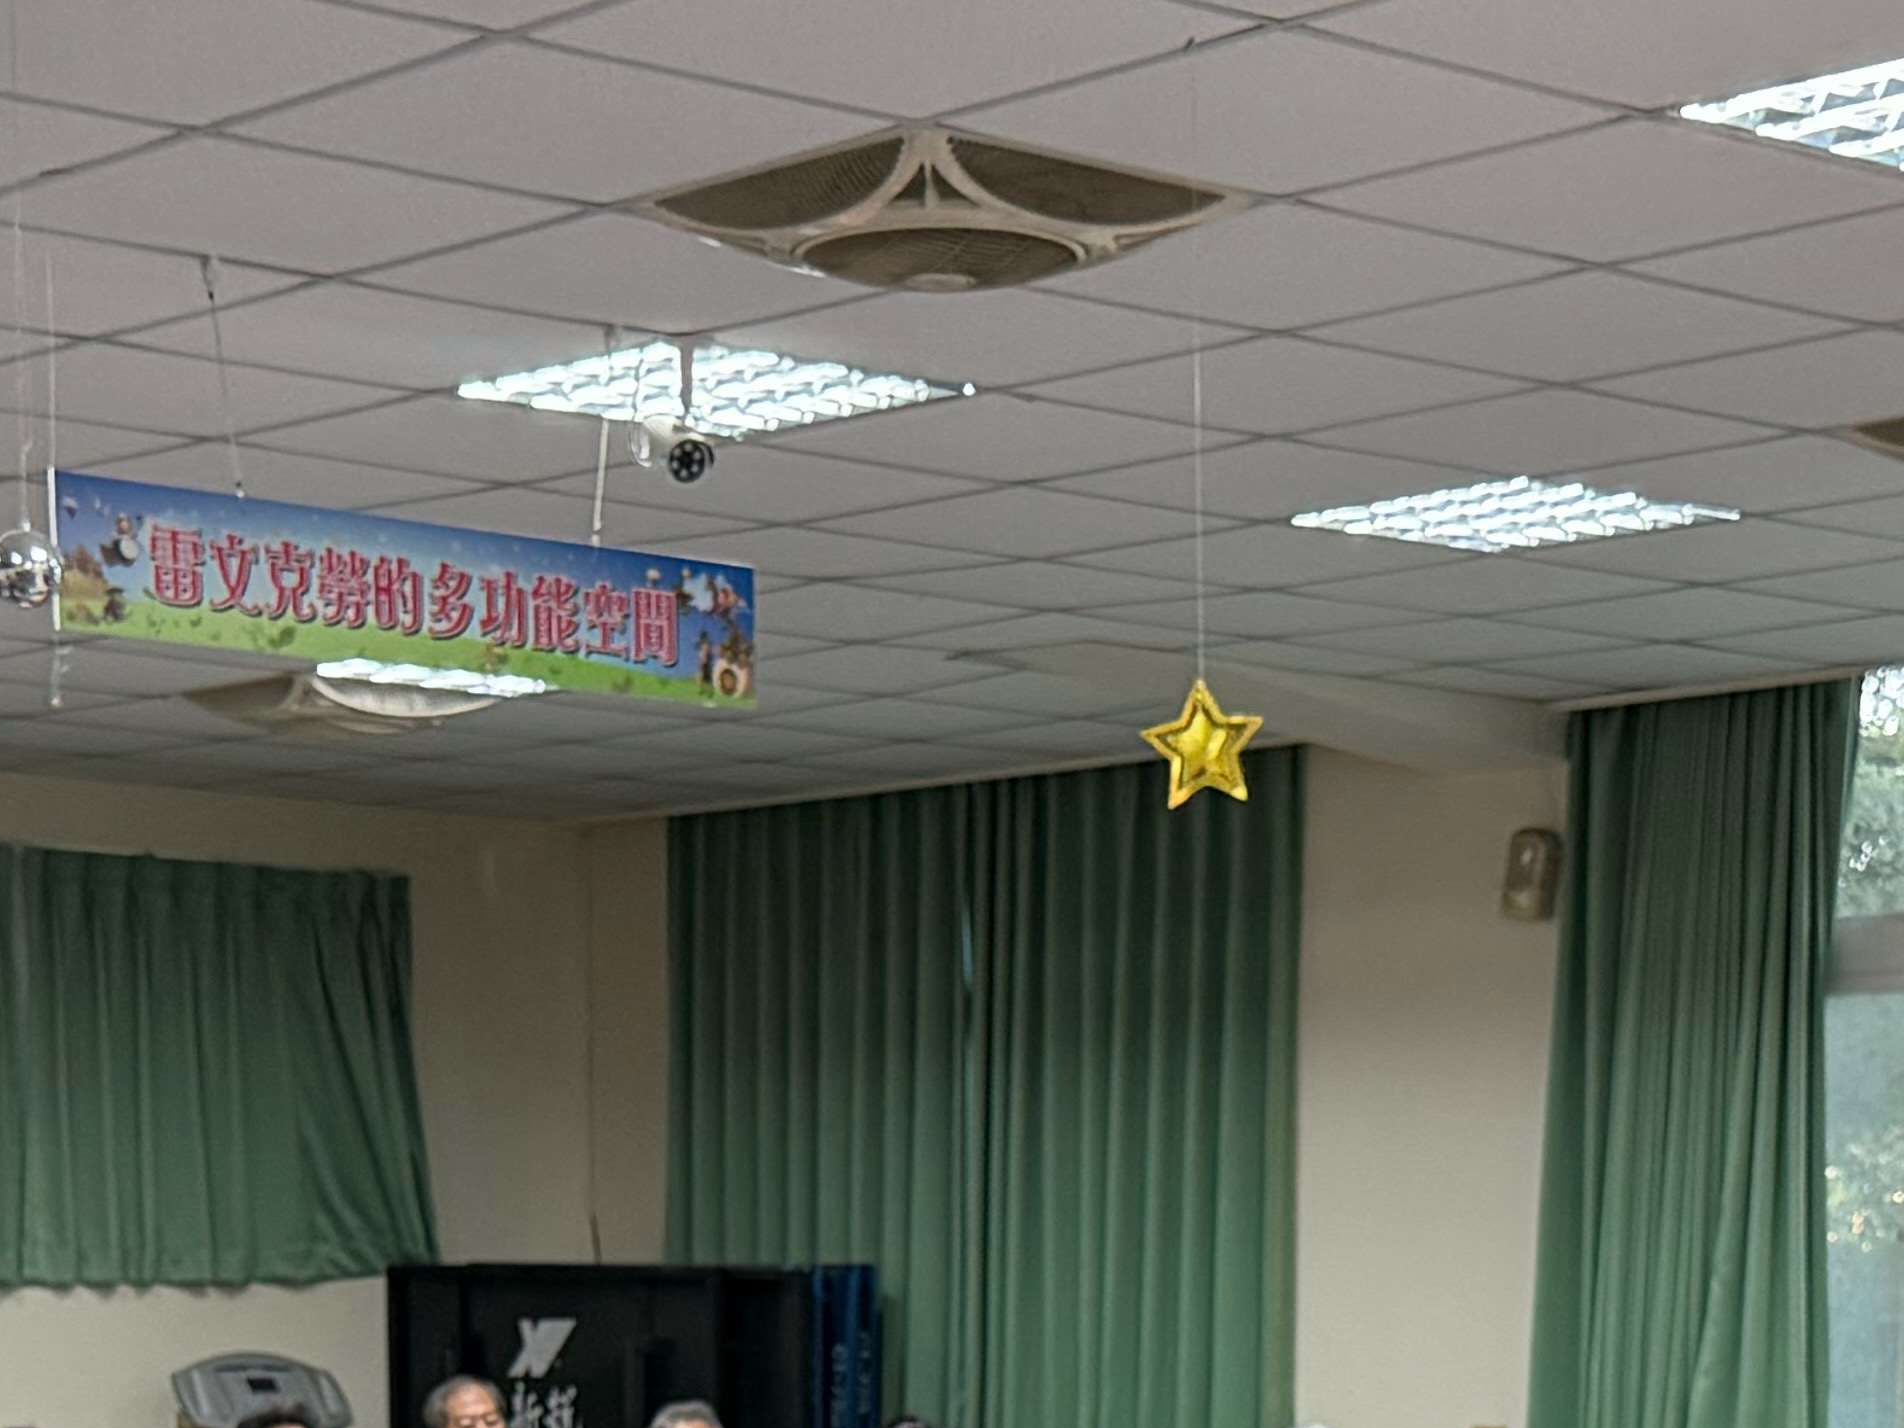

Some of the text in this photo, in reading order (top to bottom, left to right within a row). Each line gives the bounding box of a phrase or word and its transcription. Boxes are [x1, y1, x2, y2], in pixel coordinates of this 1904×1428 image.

[148, 522, 682, 666] 雷文克勞的多功能空間
